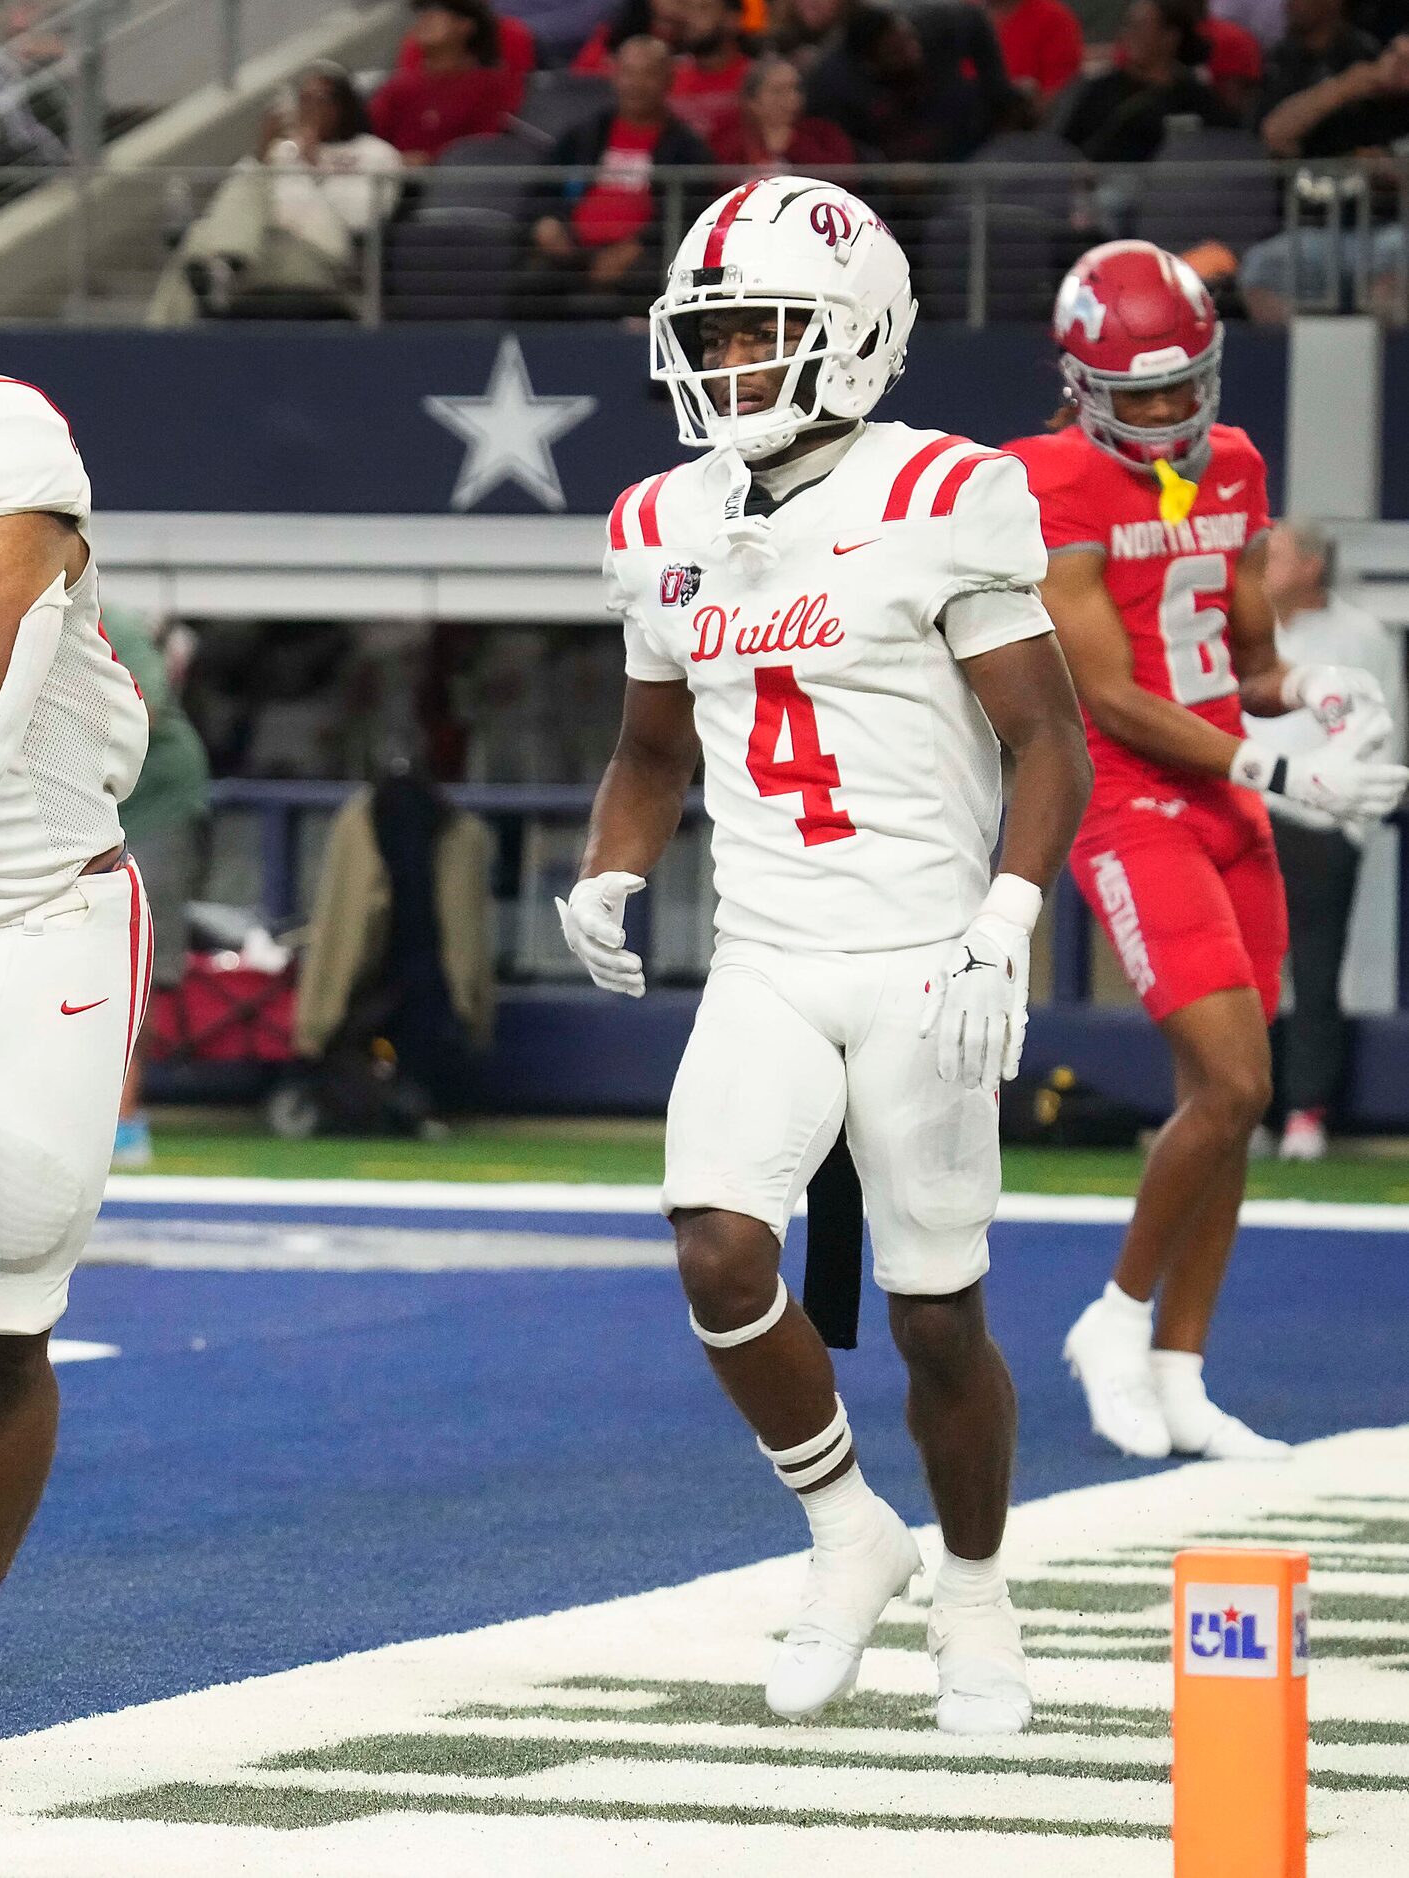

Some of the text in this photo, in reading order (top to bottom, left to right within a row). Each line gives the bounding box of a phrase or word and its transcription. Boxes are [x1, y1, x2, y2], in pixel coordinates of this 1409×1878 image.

[690, 592, 846, 663] D'ville
[1158, 552, 1239, 706] 6
[745, 664, 857, 848] 4
